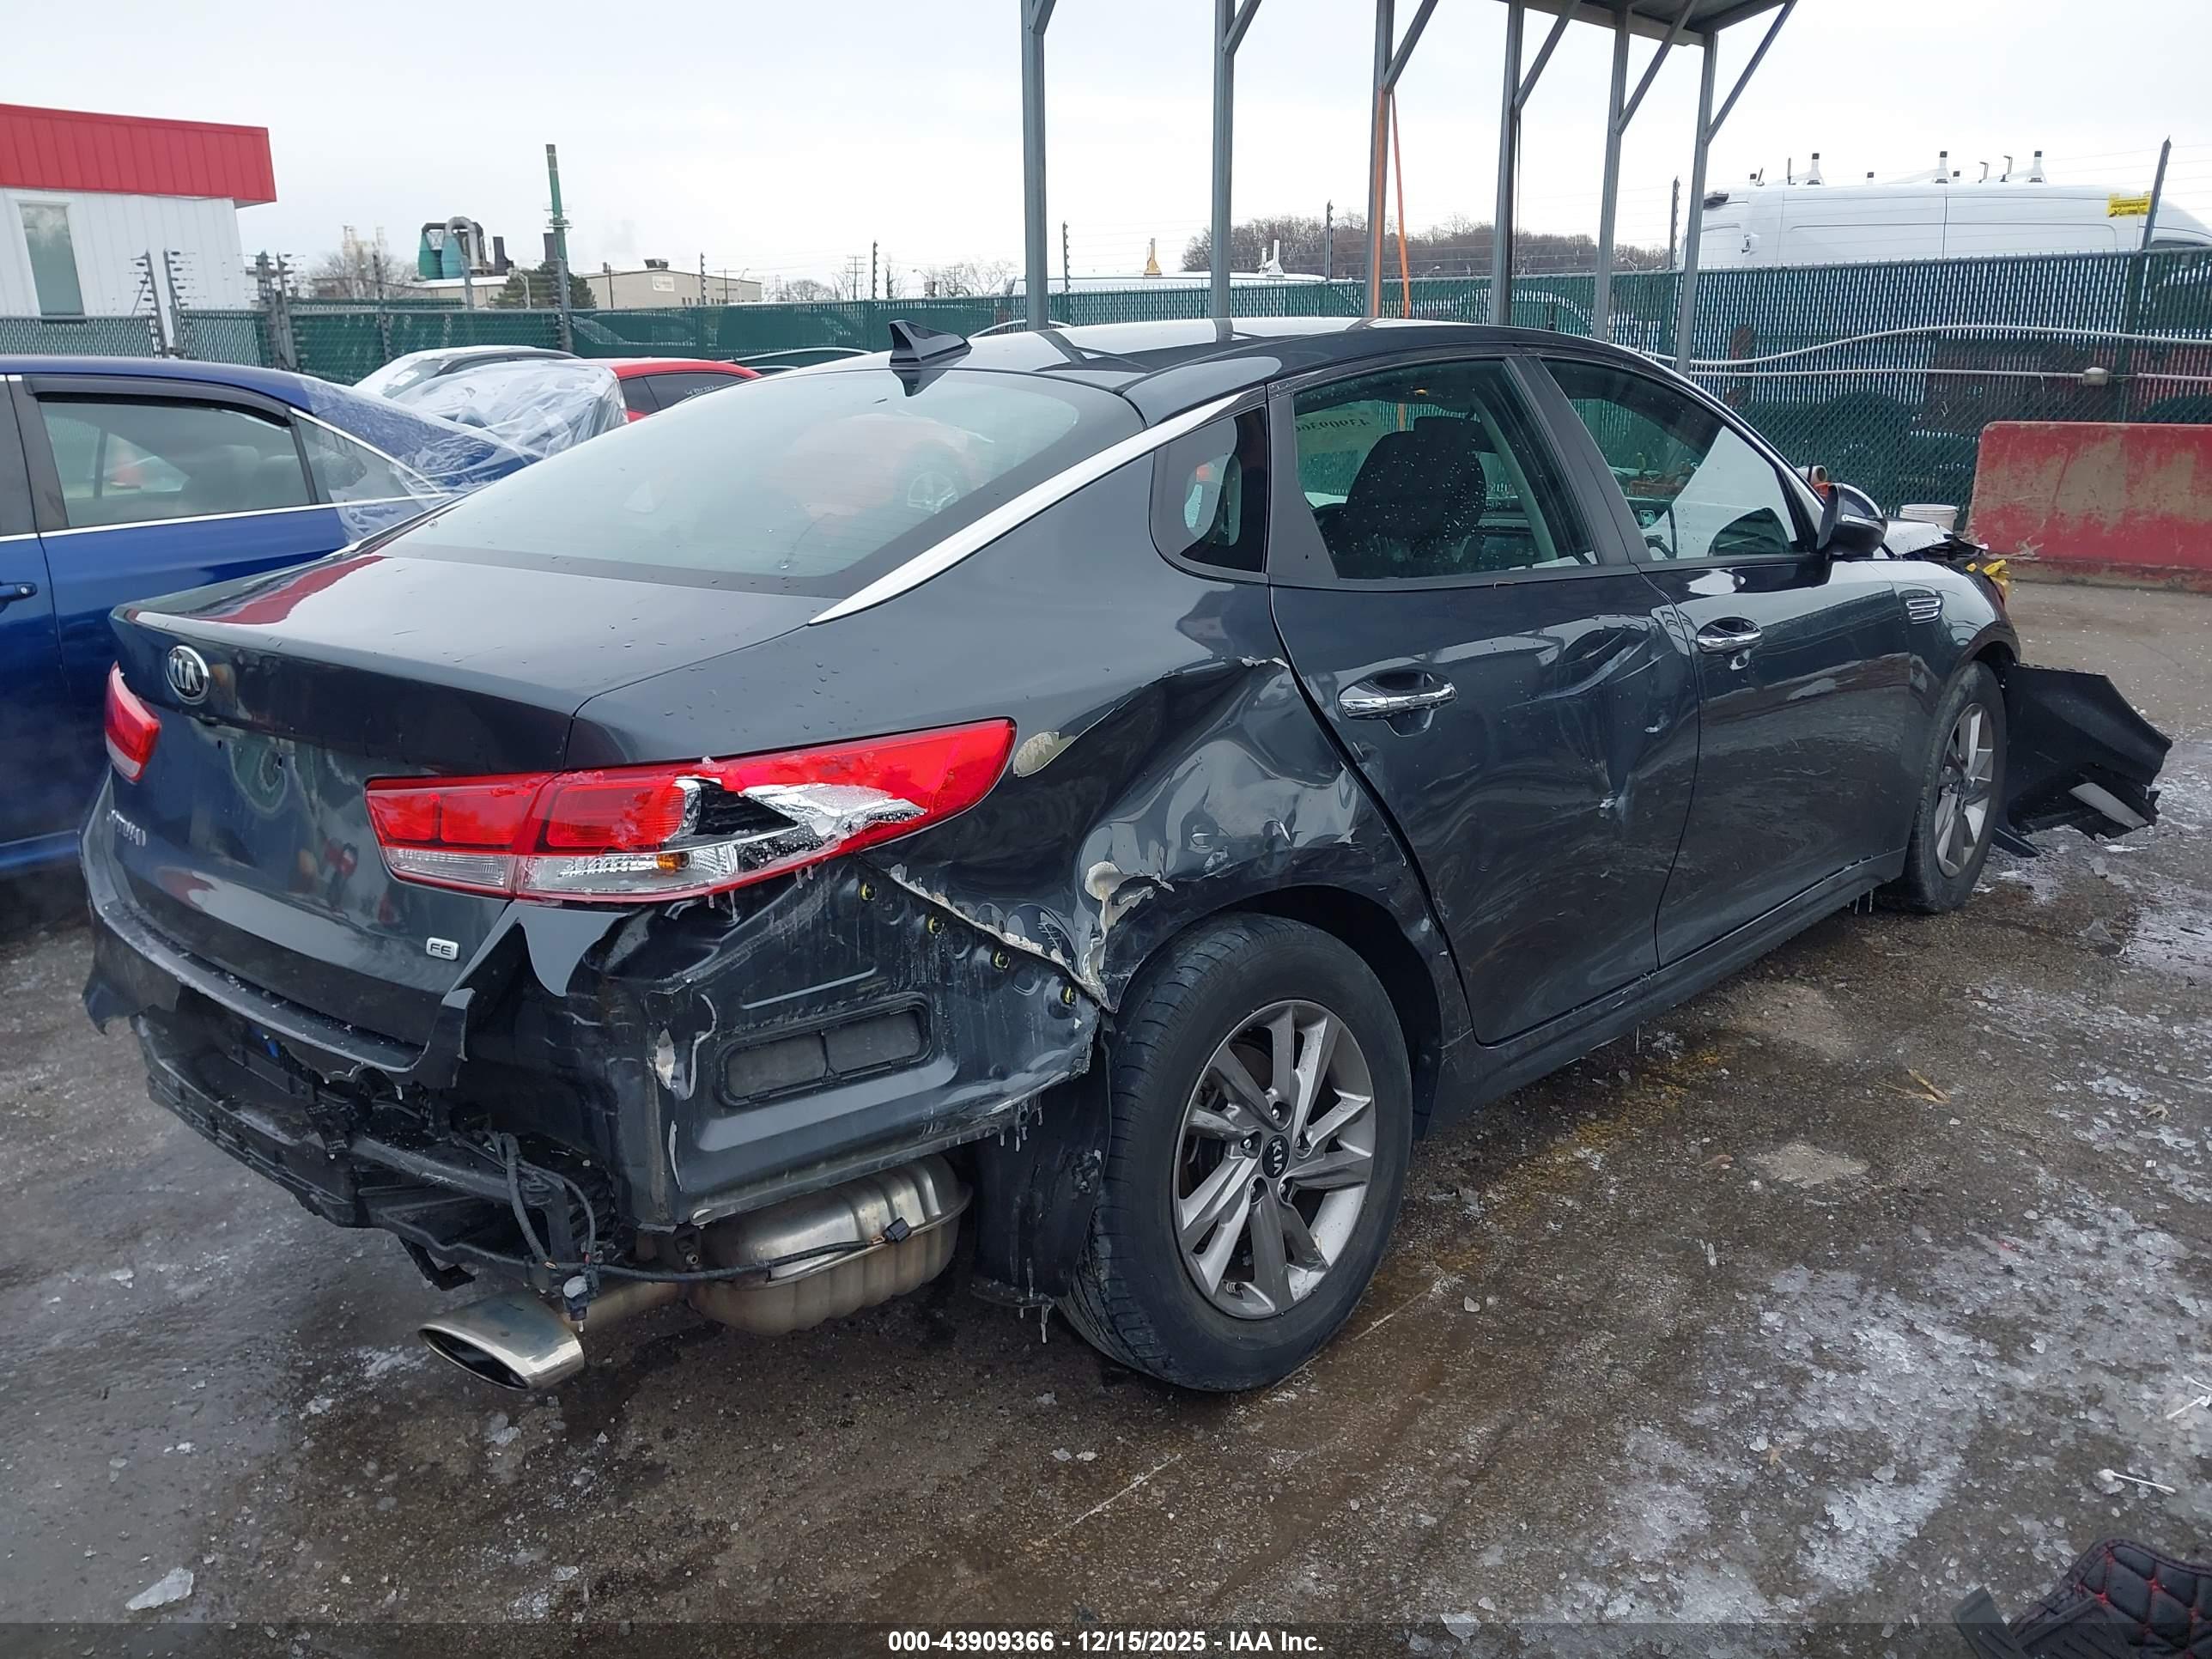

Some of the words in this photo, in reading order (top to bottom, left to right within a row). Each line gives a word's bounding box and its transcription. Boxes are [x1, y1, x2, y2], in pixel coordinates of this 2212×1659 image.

[169, 656, 201, 691] KIA
[430, 942, 452, 957] FE
[1272, 1139, 1283, 1176] KIA
